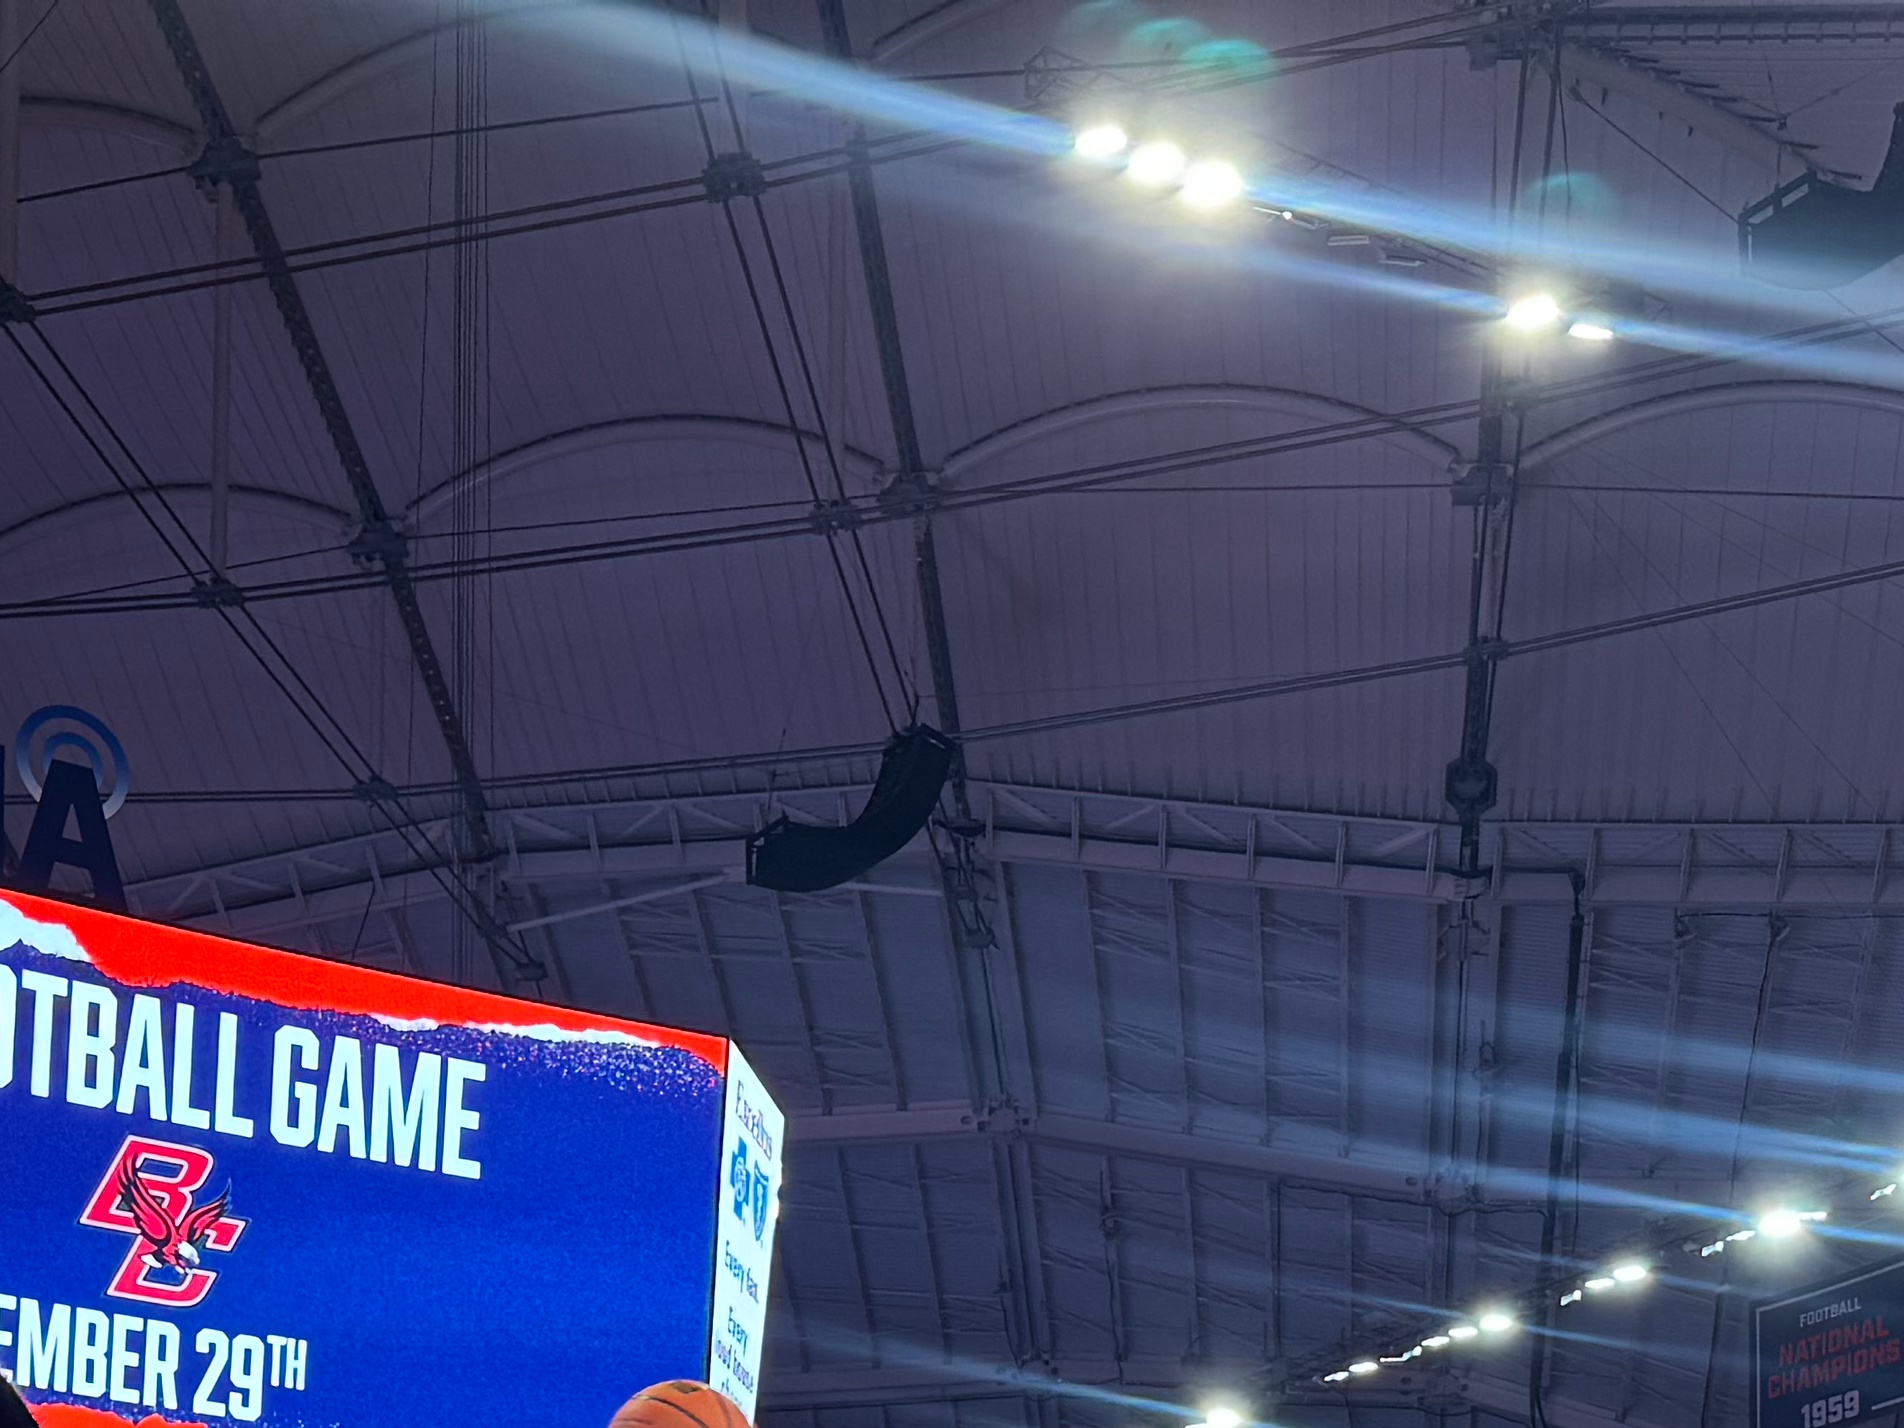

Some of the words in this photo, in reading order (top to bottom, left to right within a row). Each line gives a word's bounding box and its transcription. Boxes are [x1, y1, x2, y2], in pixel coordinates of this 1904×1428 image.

[270, 1023, 485, 1179] GAME
[1779, 1316, 1889, 1366] NATIONAL
[1799, 1297, 1862, 1327] FOOTBALL
[193, 1328, 309, 1422] 29TH
[1767, 1338, 1901, 1399] CHAMPIONS
